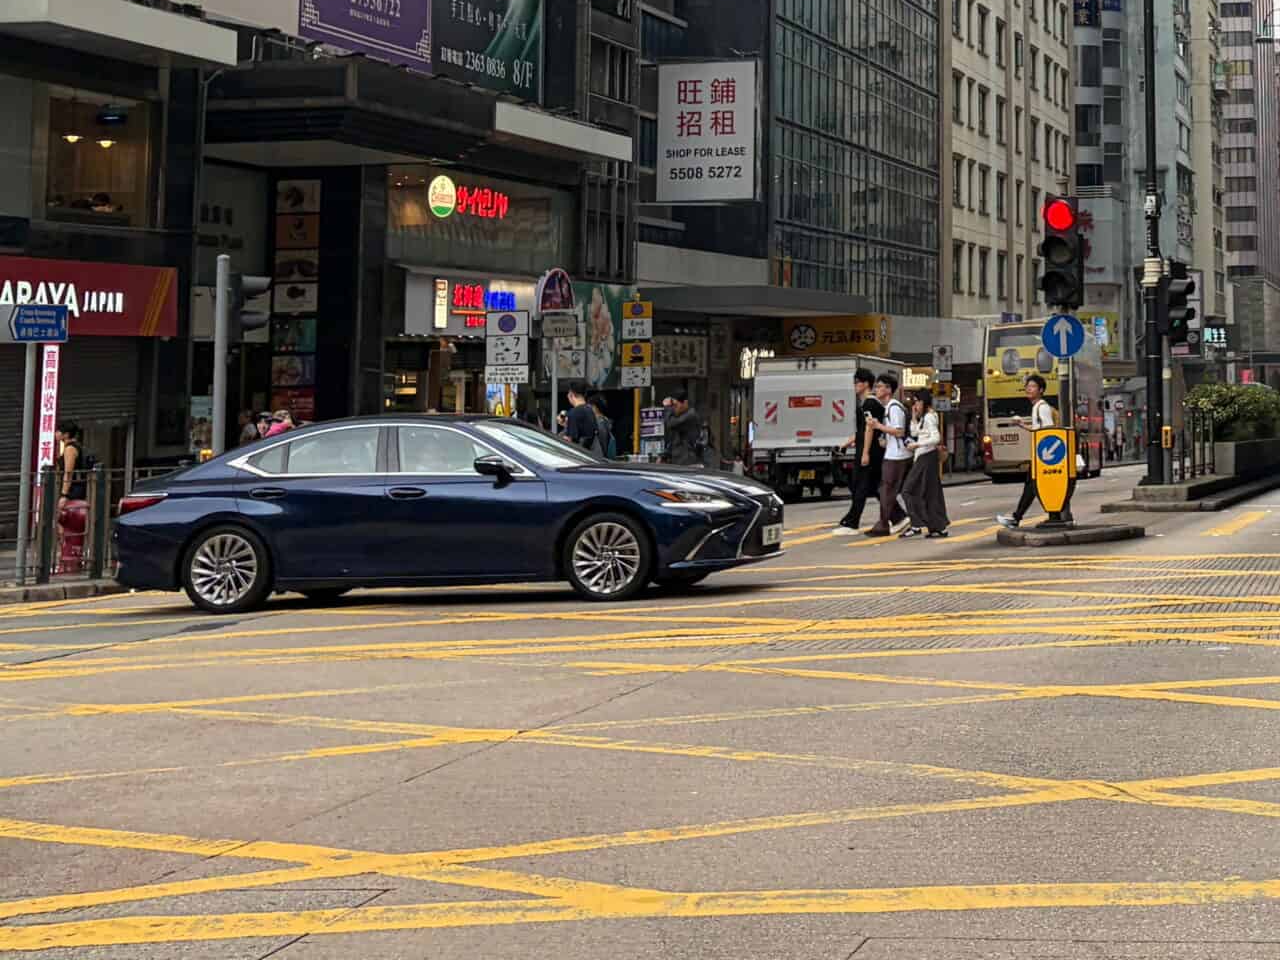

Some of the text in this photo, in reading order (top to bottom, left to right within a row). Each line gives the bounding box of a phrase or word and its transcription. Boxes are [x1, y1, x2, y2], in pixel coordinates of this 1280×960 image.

[464, 49, 485, 73] 2363
[512, 58, 534, 89] 8/F
[677, 77, 736, 105] 旺鋪
[677, 110, 737, 137] 招租
[665, 146, 748, 159] SHOP FOR LEASE
[669, 165, 743, 181] 5508 5272
[82, 290, 124, 313] JAPAN
